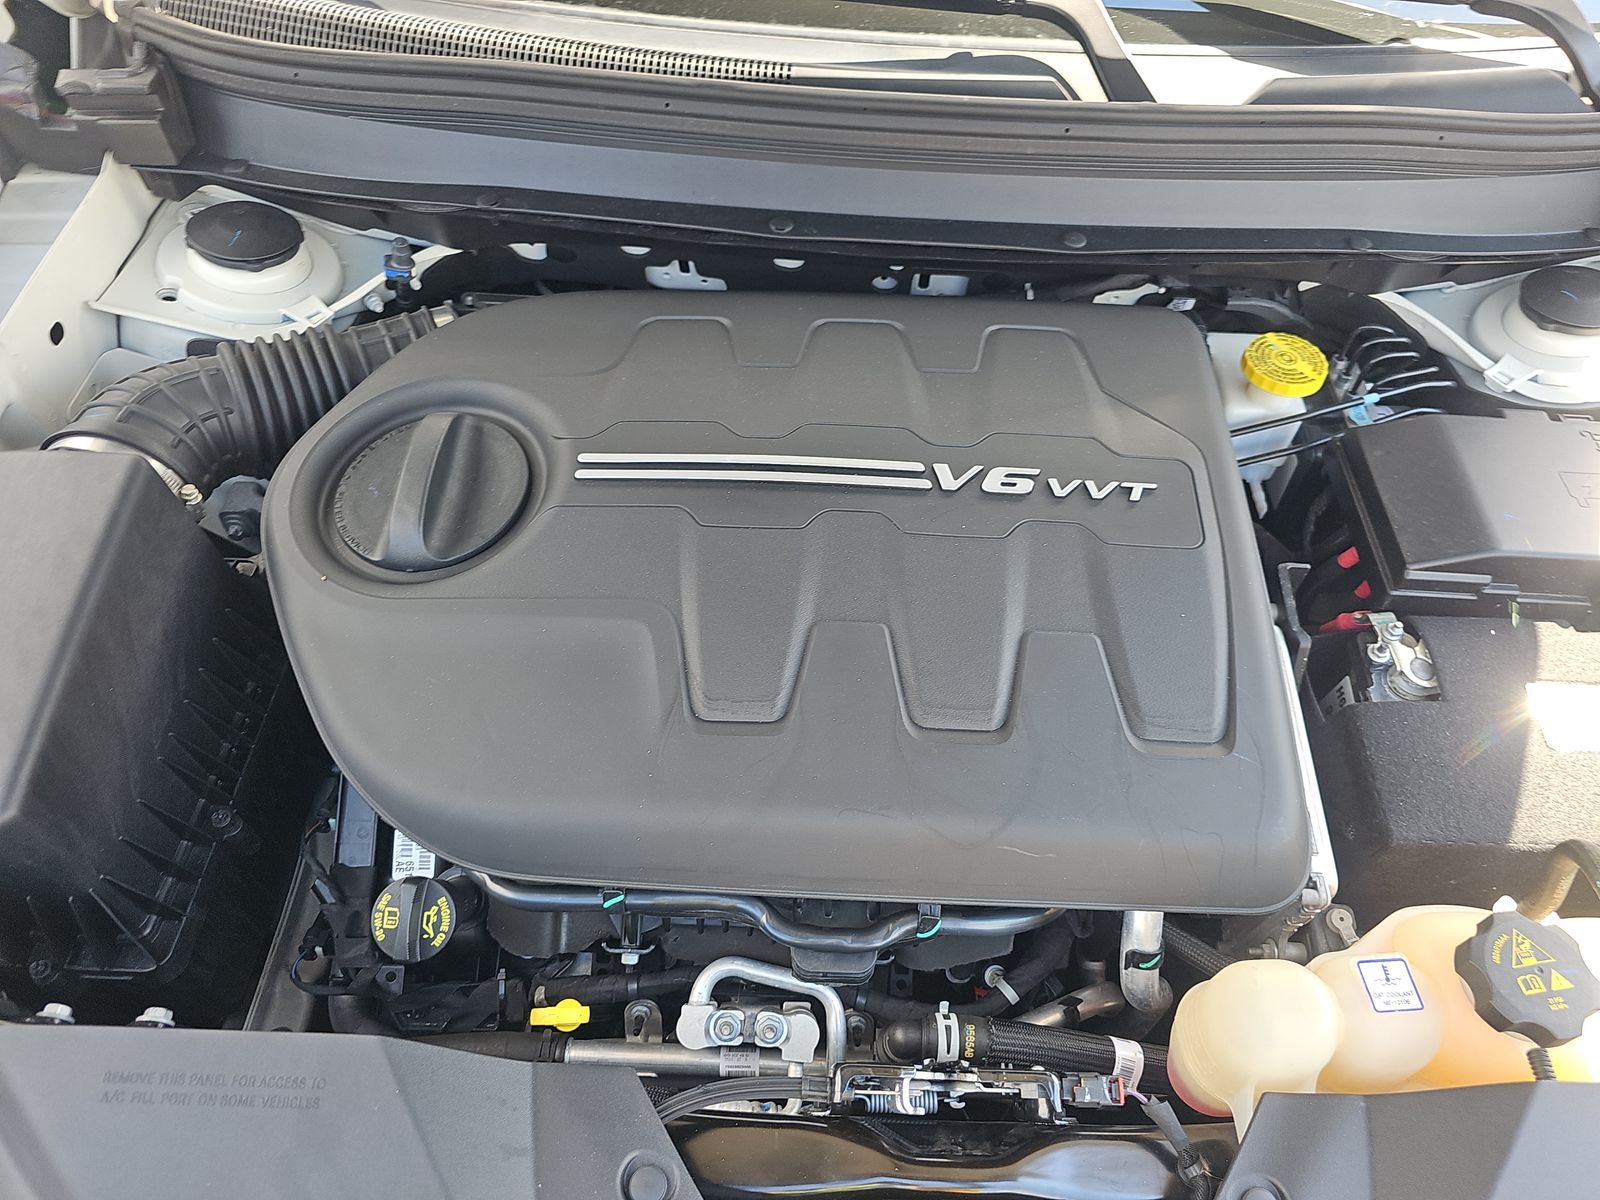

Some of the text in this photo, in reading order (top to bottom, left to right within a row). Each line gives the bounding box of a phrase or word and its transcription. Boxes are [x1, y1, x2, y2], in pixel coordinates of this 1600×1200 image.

[932, 463, 1158, 502] V6 VVT
[376, 892, 392, 912] SAE
[431, 896, 451, 948] ENGINE OIL
[102, 1070, 327, 1090] REMOVE THIS PANEL FOR ACCESS TO
[100, 1089, 321, 1110] A/C FILL PORT ON SOME VEHICLES
